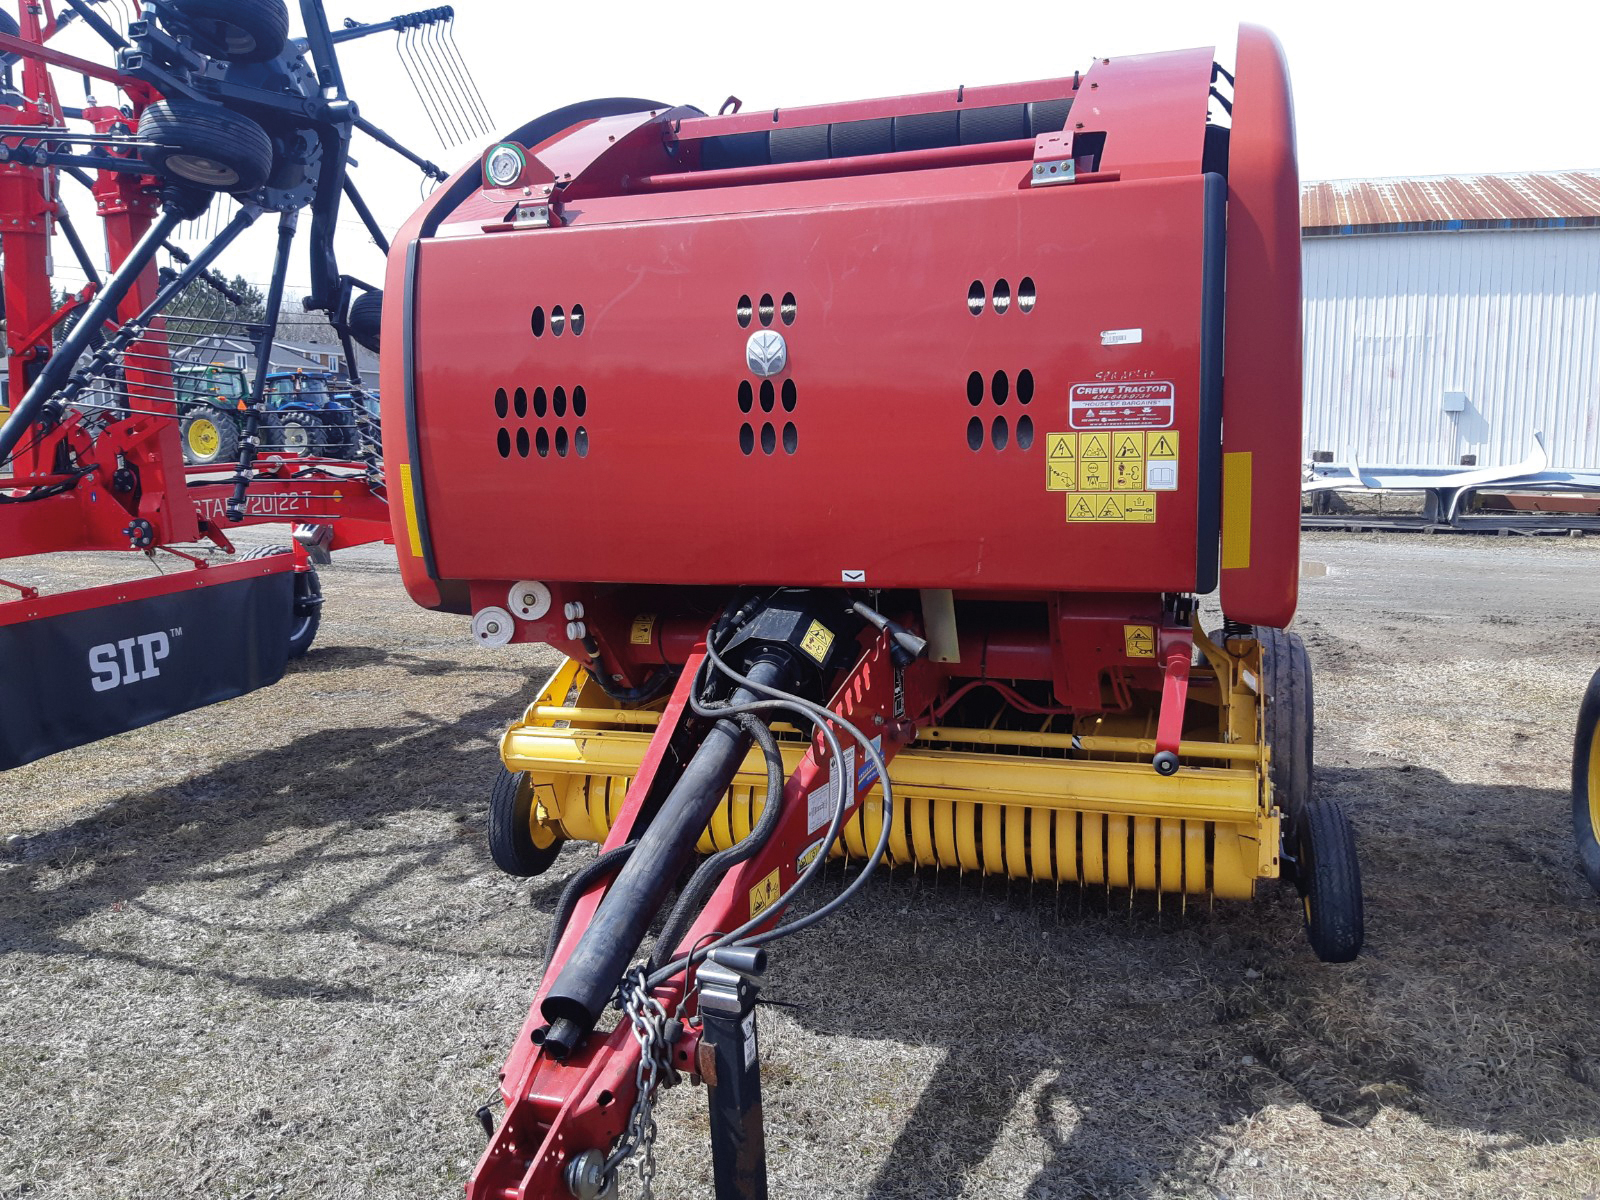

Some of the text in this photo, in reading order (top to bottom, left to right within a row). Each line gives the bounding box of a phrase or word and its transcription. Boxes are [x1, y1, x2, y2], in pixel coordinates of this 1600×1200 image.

[1076, 385, 1167, 395] CREWE TRACTOR
[89, 631, 170, 692] SIP
